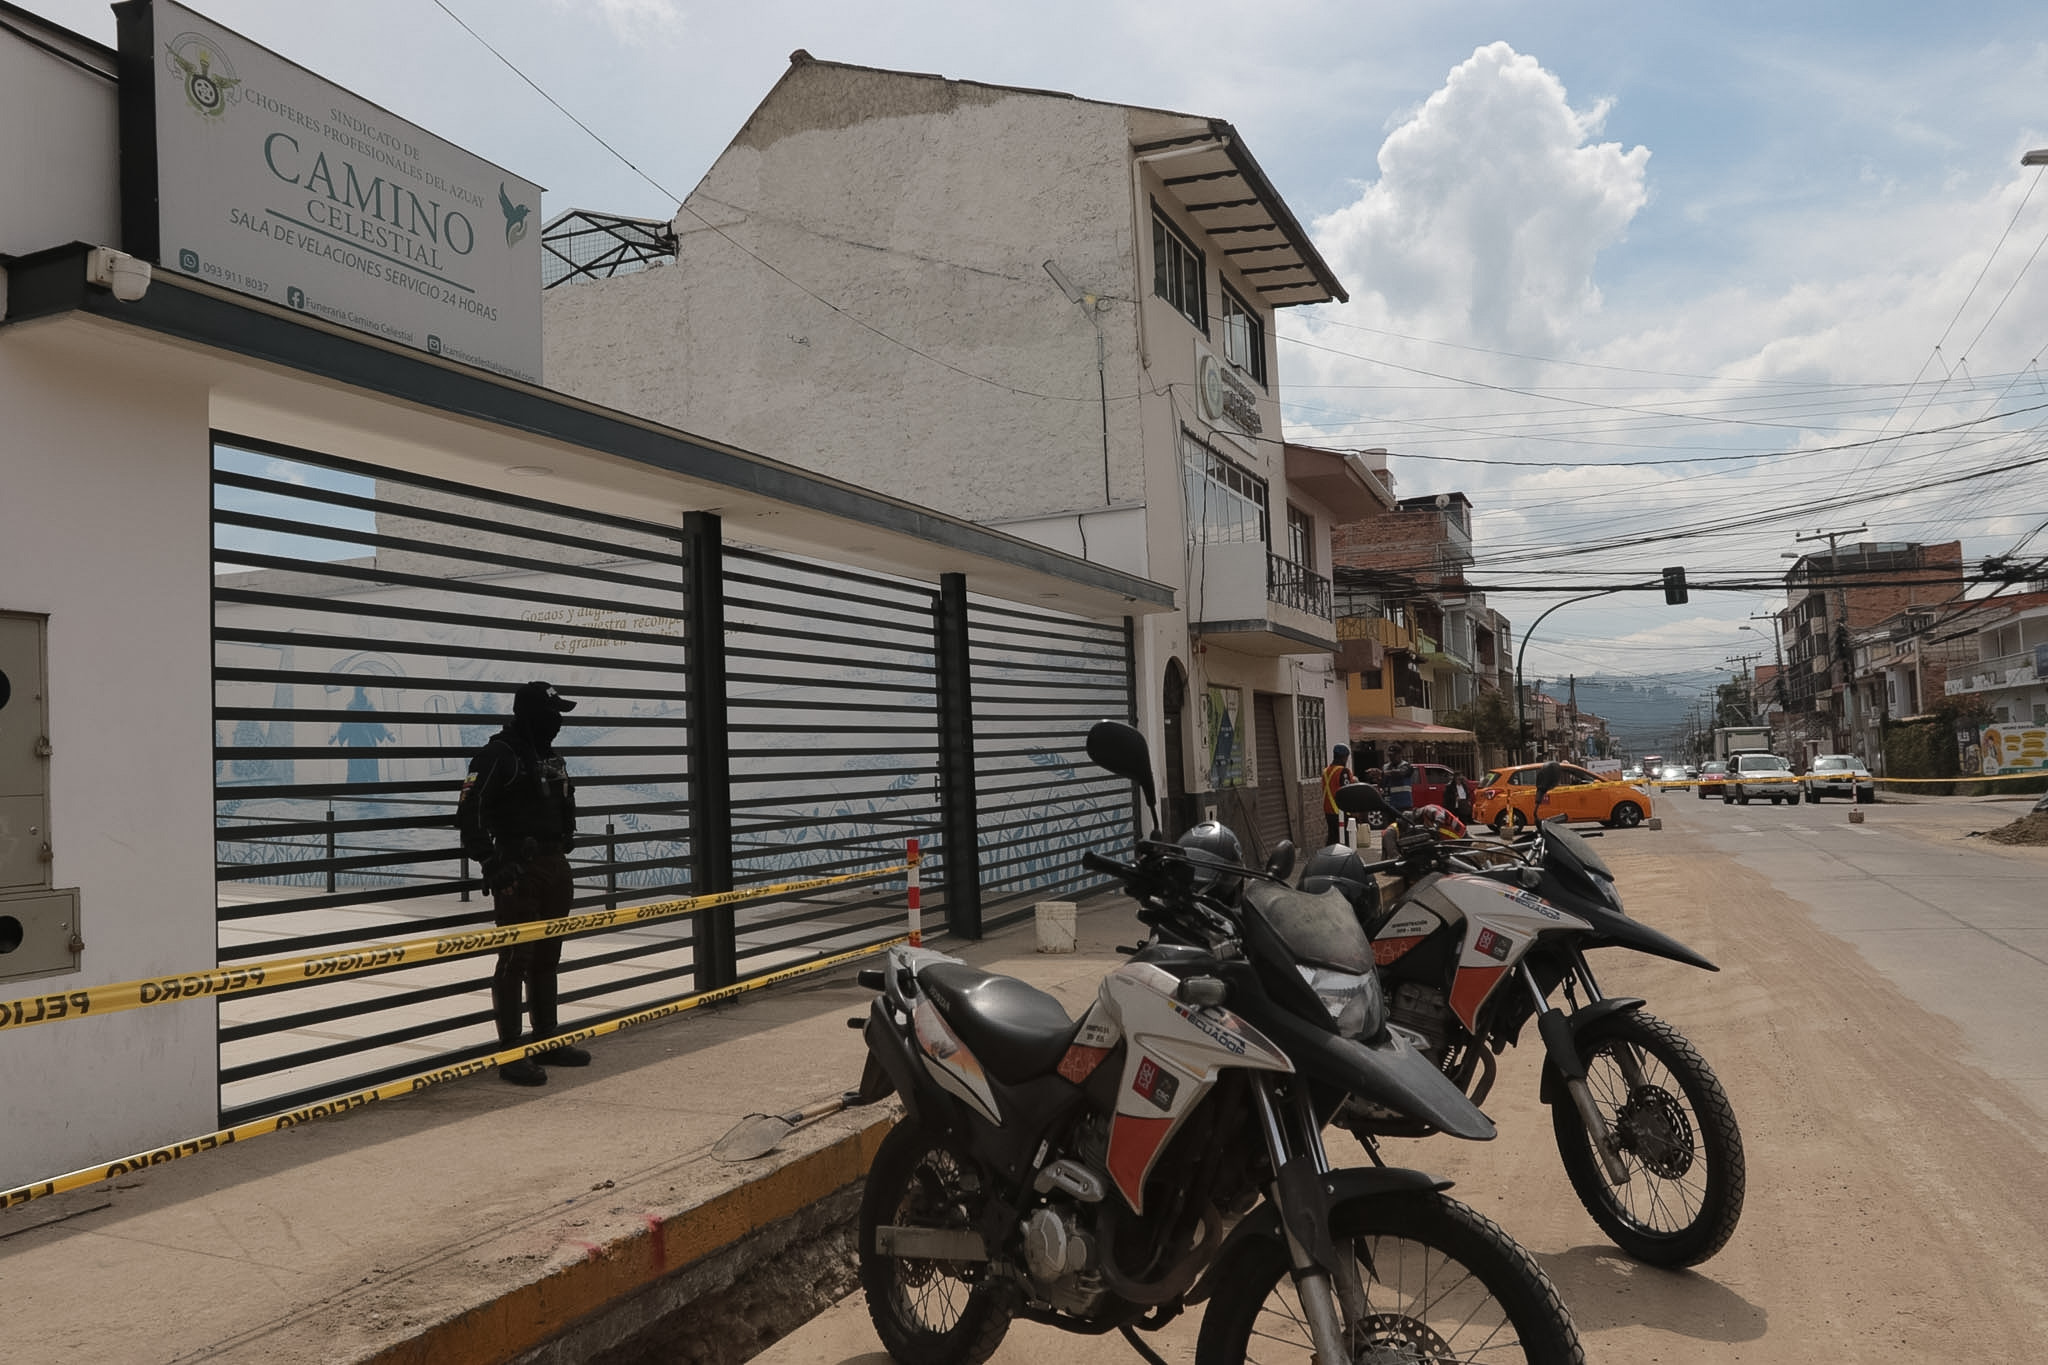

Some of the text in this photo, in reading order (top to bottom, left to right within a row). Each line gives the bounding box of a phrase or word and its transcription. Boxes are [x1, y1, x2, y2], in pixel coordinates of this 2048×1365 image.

[245, 88, 485, 209] CHOFERES PROFESIONALES DEL AZUAY
[330, 108, 419, 160] SINDICATO DE
[264, 132, 474, 255] CAMINO
[307, 199, 443, 271] CELESTIAL
[230, 208, 498, 321] SALA DE VELACIONES SERVICIO 24 HORAS
[1187, 1014, 1245, 1055] ECUADOR
